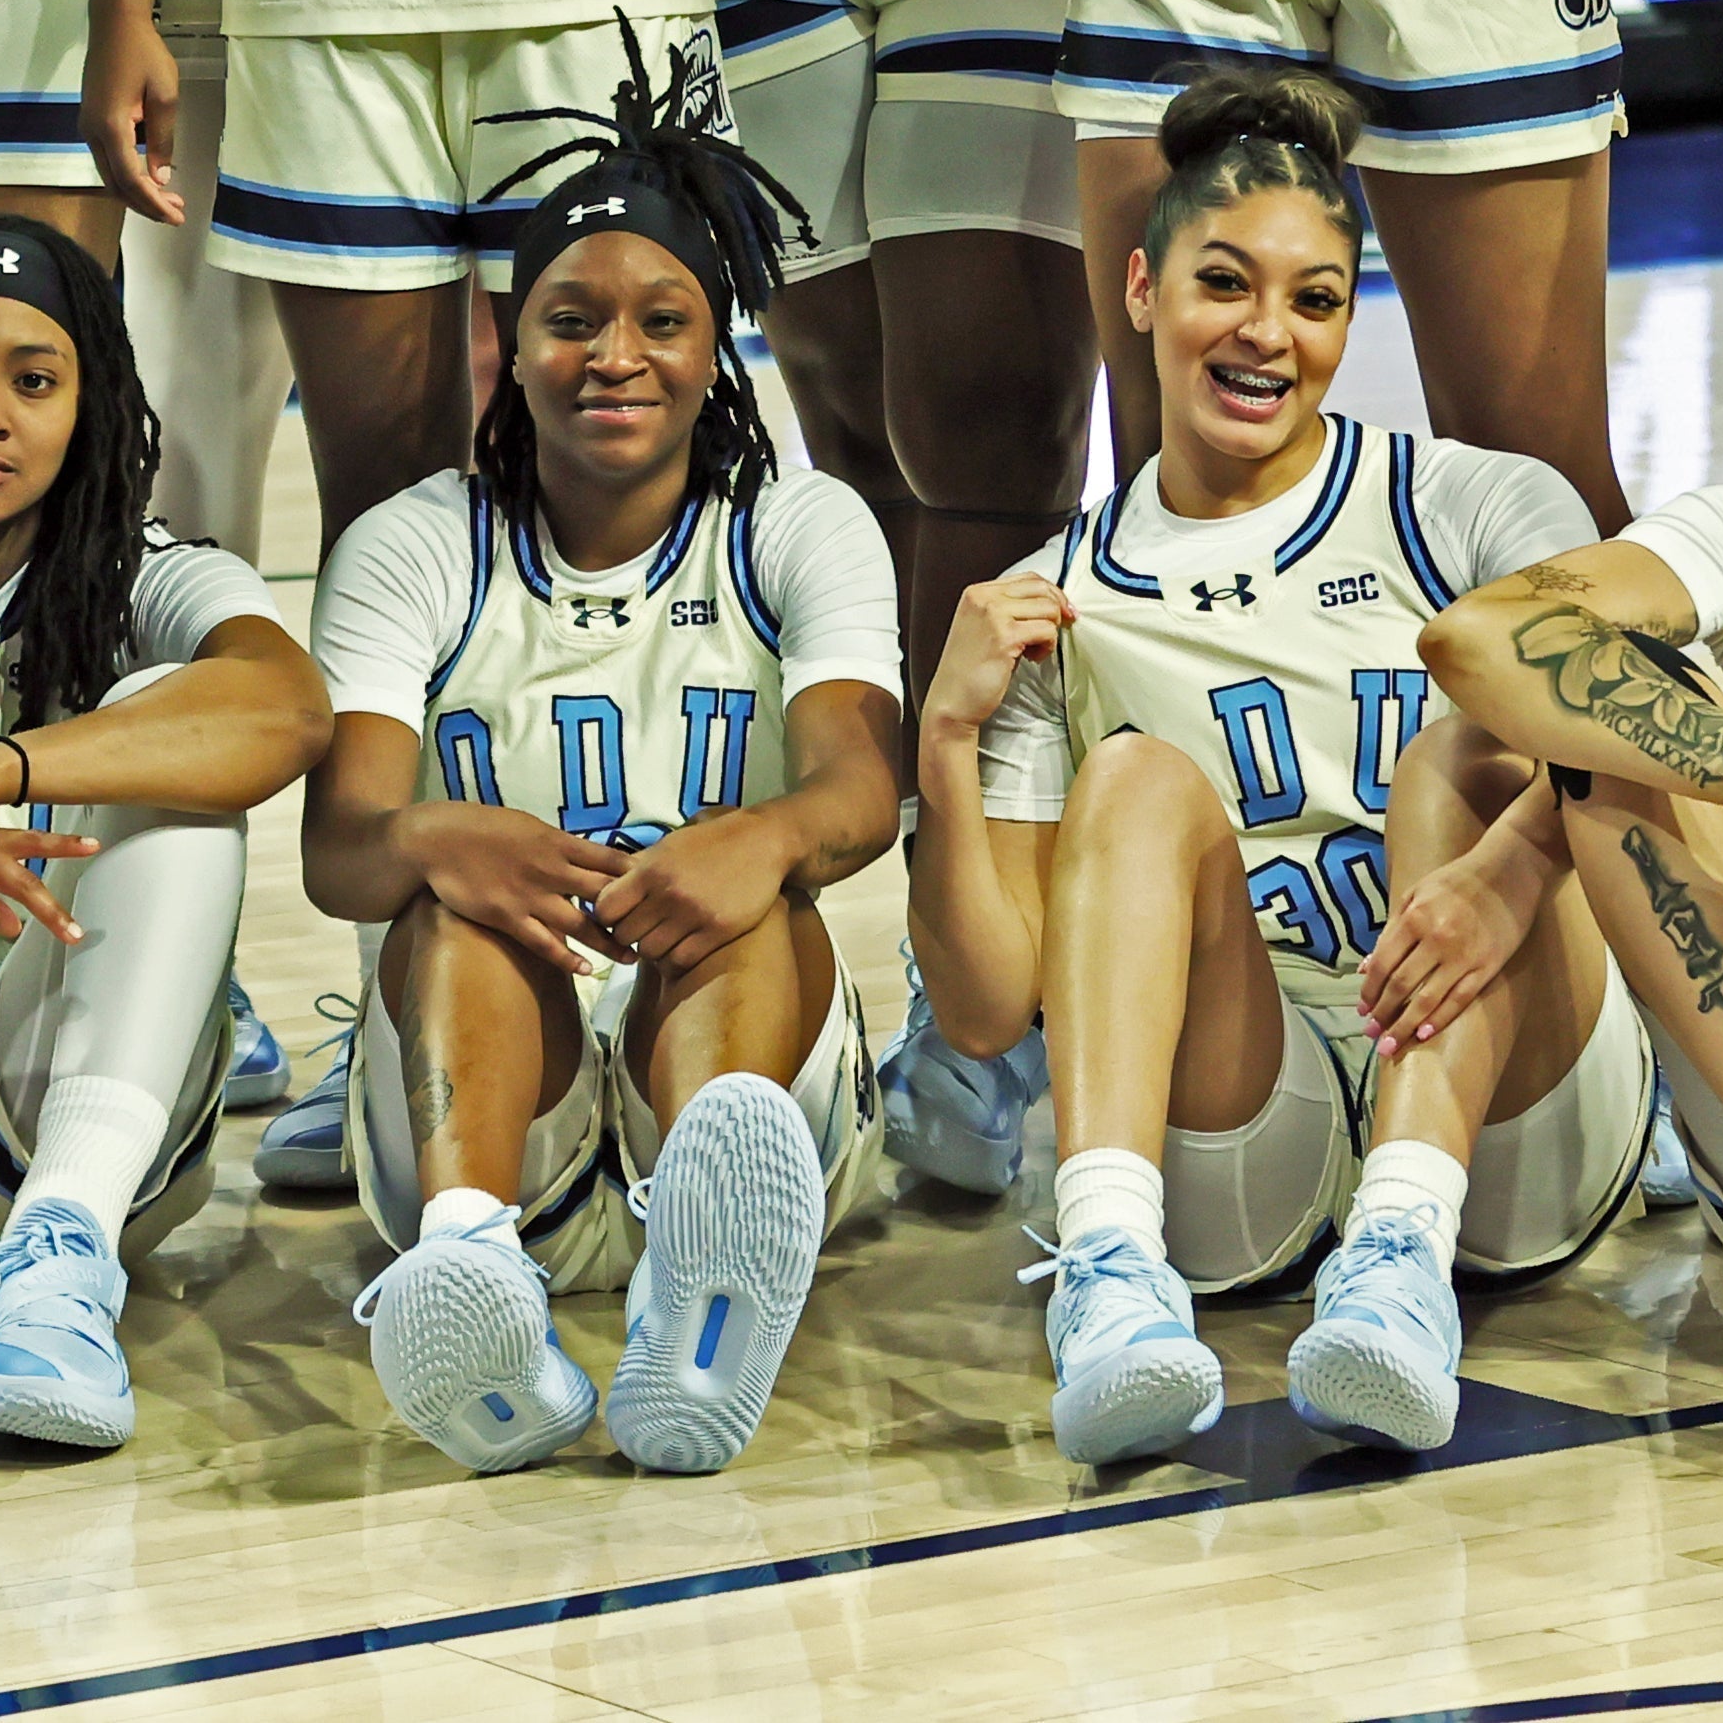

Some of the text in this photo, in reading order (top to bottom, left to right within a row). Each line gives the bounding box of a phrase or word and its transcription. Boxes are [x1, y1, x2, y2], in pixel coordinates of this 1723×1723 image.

[1318, 572, 1380, 608] SBC
[434, 685, 757, 834] ODU
[1244, 829, 1389, 968] 30
